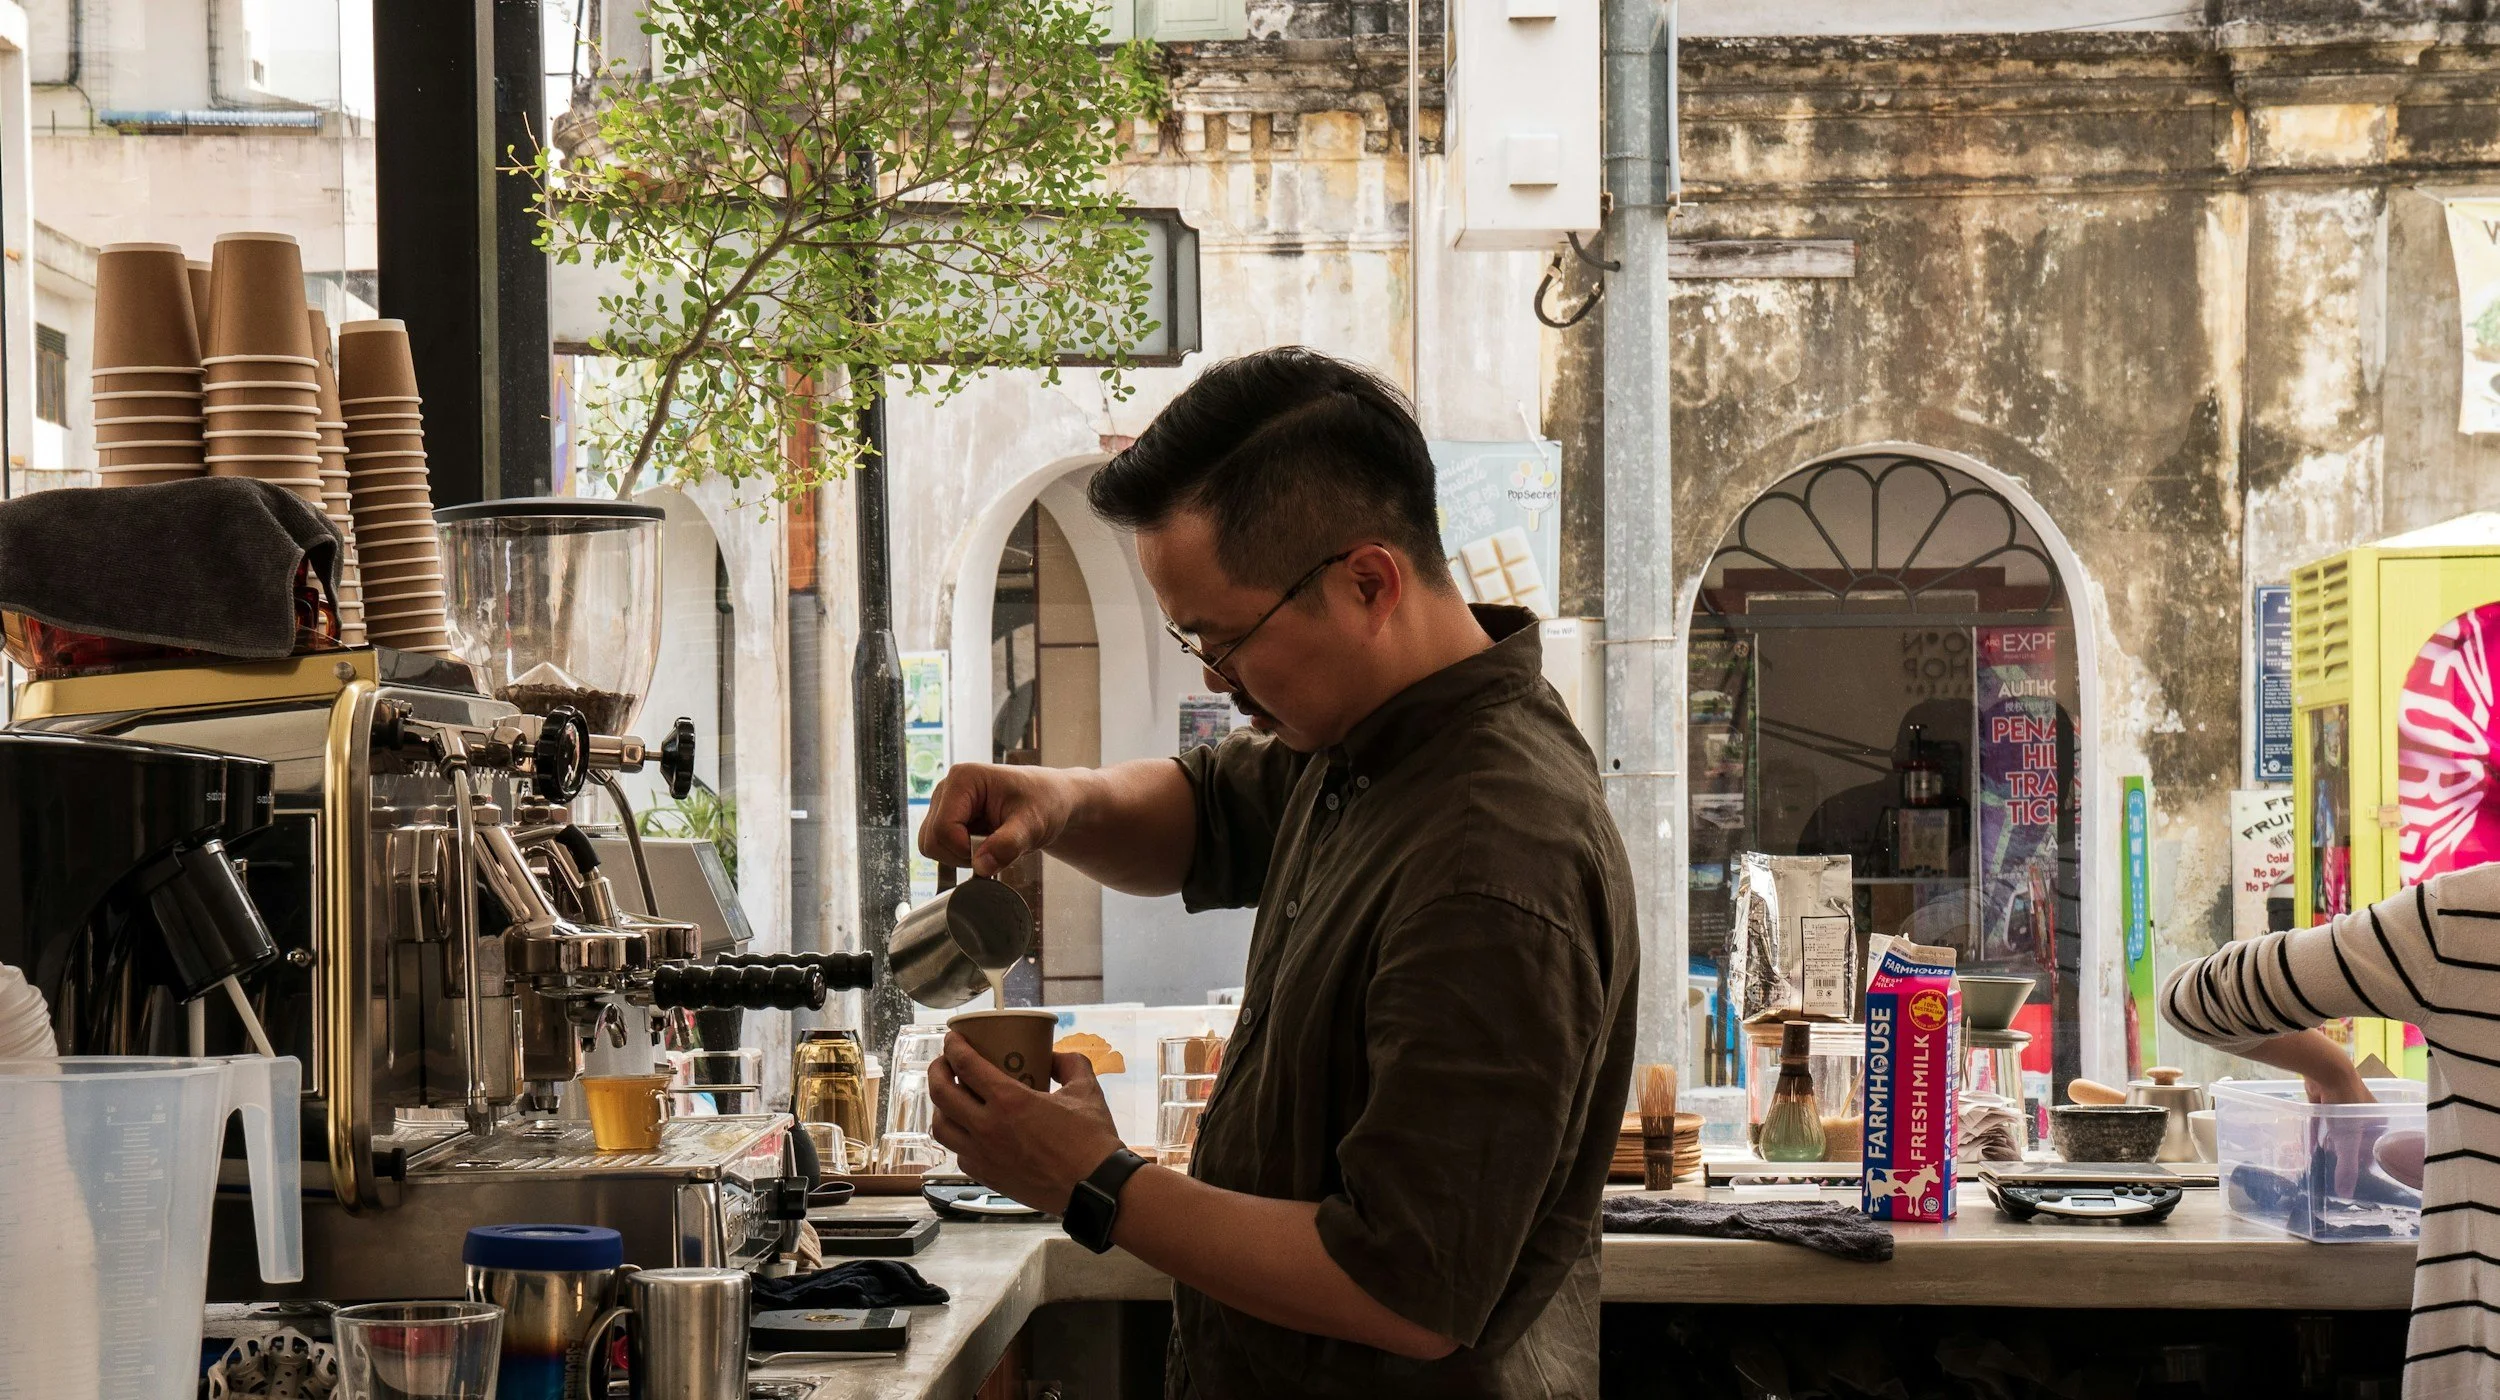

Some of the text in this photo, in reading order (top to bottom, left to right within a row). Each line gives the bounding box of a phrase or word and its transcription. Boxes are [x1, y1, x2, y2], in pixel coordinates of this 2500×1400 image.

[2242, 812, 2294, 840] FRUI
[2266, 853, 2289, 864] Cold
[1885, 957, 1951, 976] FARMHOUSE
[1875, 981, 1895, 989] MILK
[1878, 974, 1903, 984] FRESH
[1867, 1007, 1891, 1159] FARMHOUSE
[1944, 1009, 1954, 1162] FARMHOUSE
[1911, 1034, 1930, 1161] FRESH MILK
